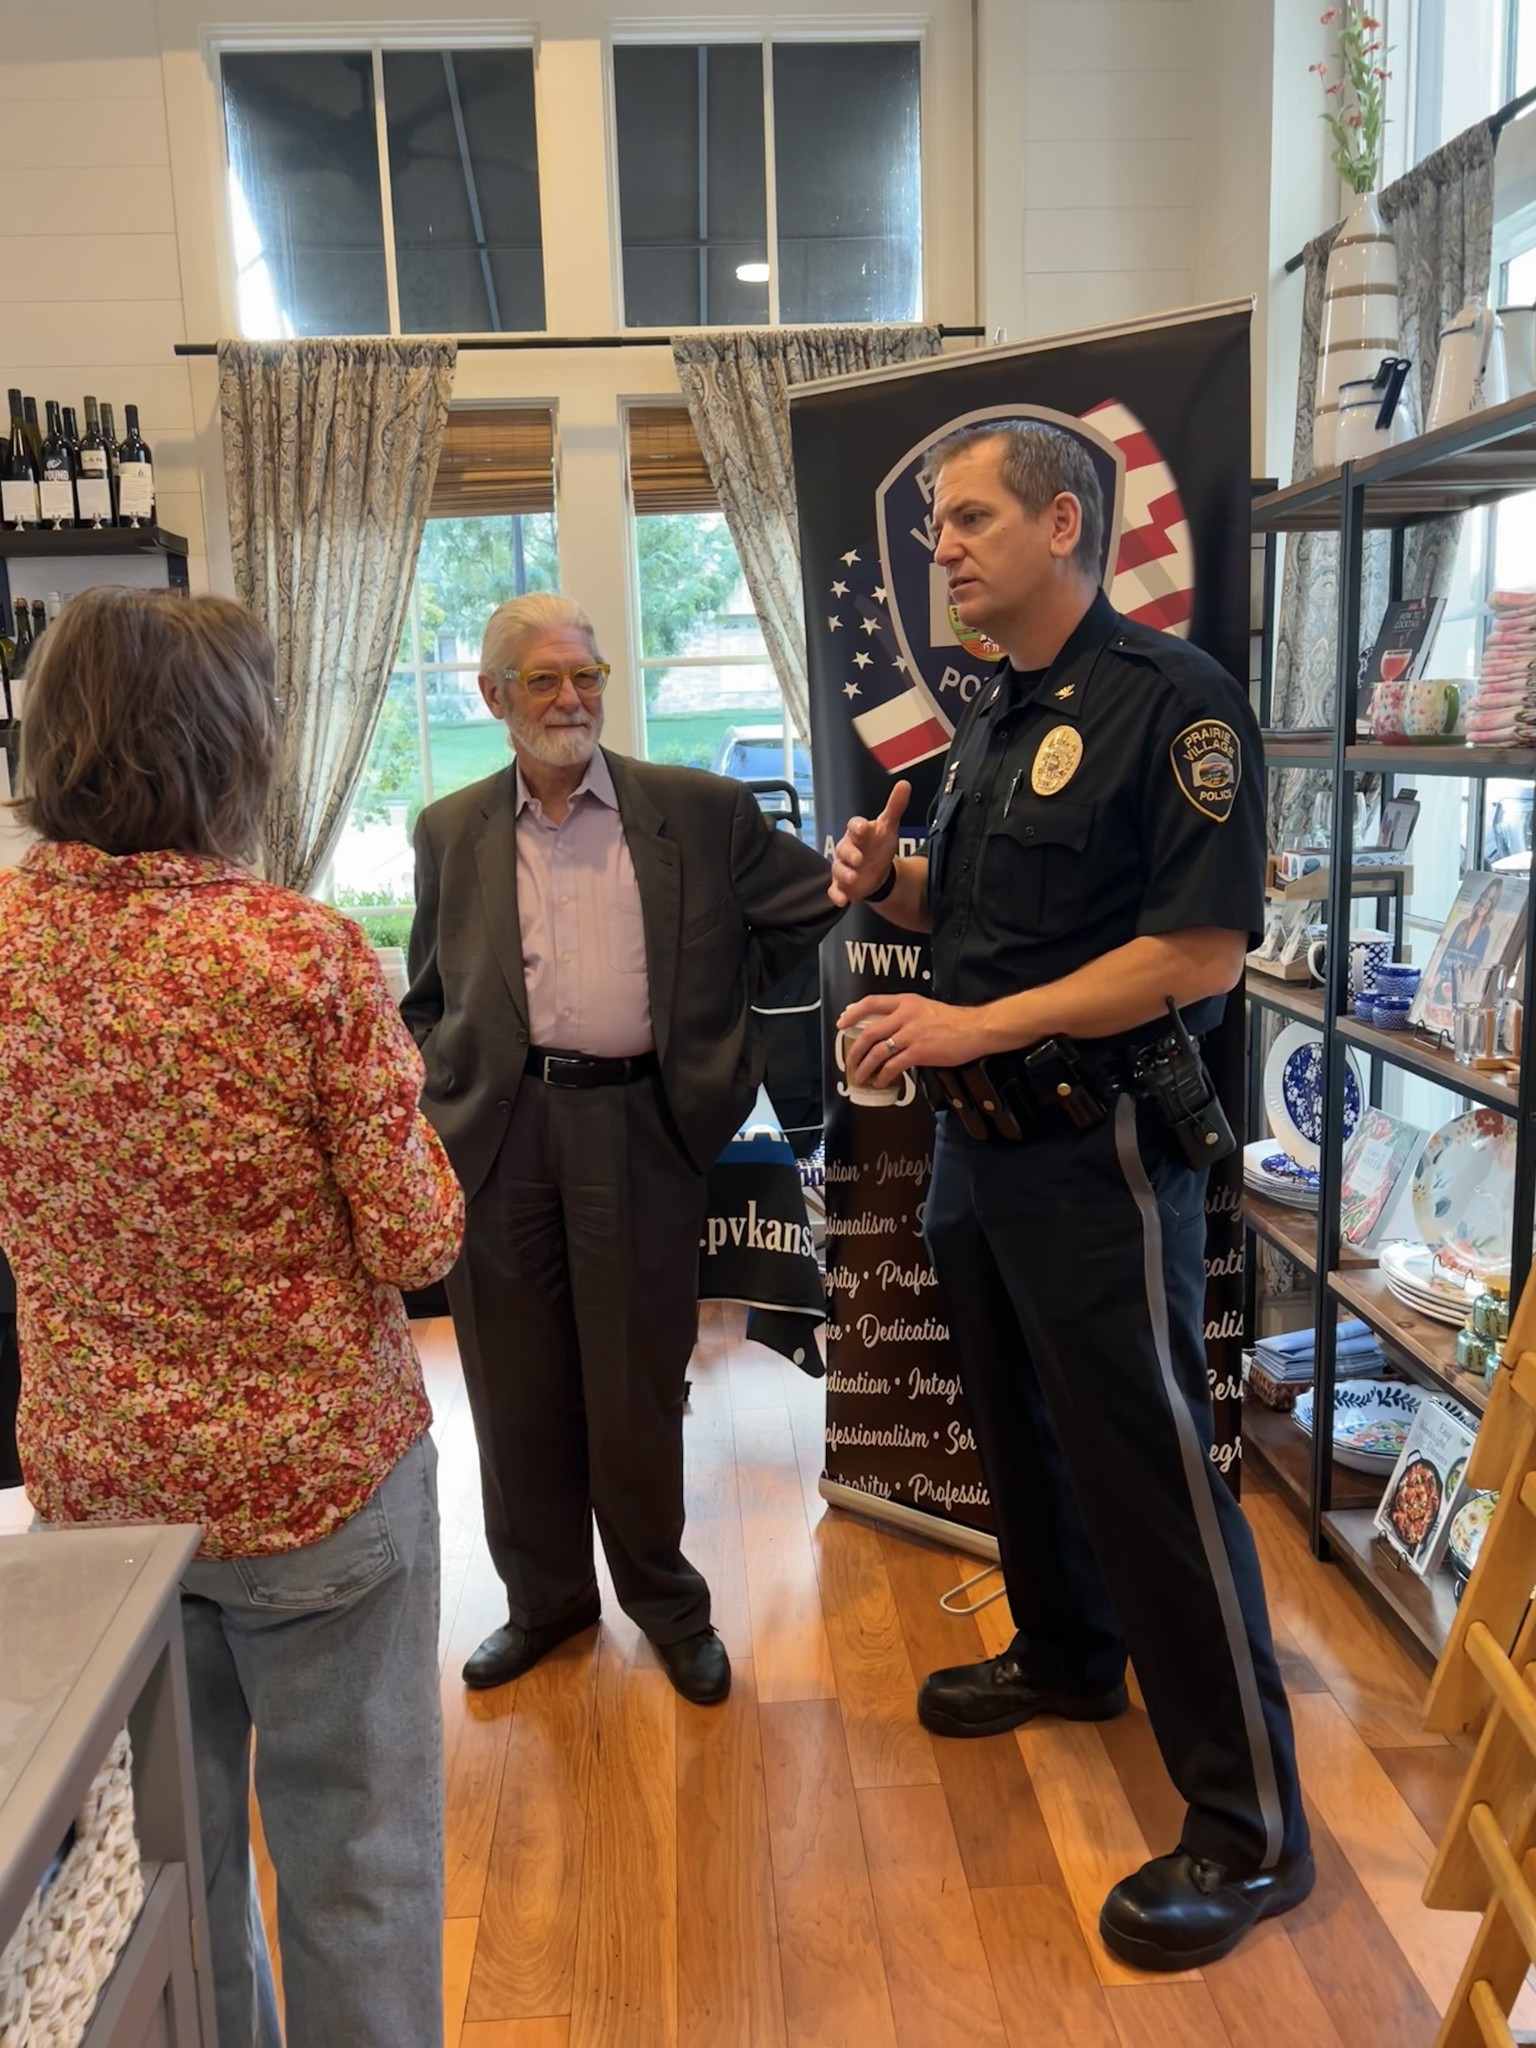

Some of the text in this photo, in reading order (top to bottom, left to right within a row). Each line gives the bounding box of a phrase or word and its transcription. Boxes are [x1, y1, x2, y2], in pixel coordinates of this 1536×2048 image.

[915, 467, 937, 505] P
[910, 514, 937, 551] V
[938, 665, 990, 703] PO
[1183, 727, 1231, 748] PRAIRIE
[1183, 739, 1235, 761] VILLAGE
